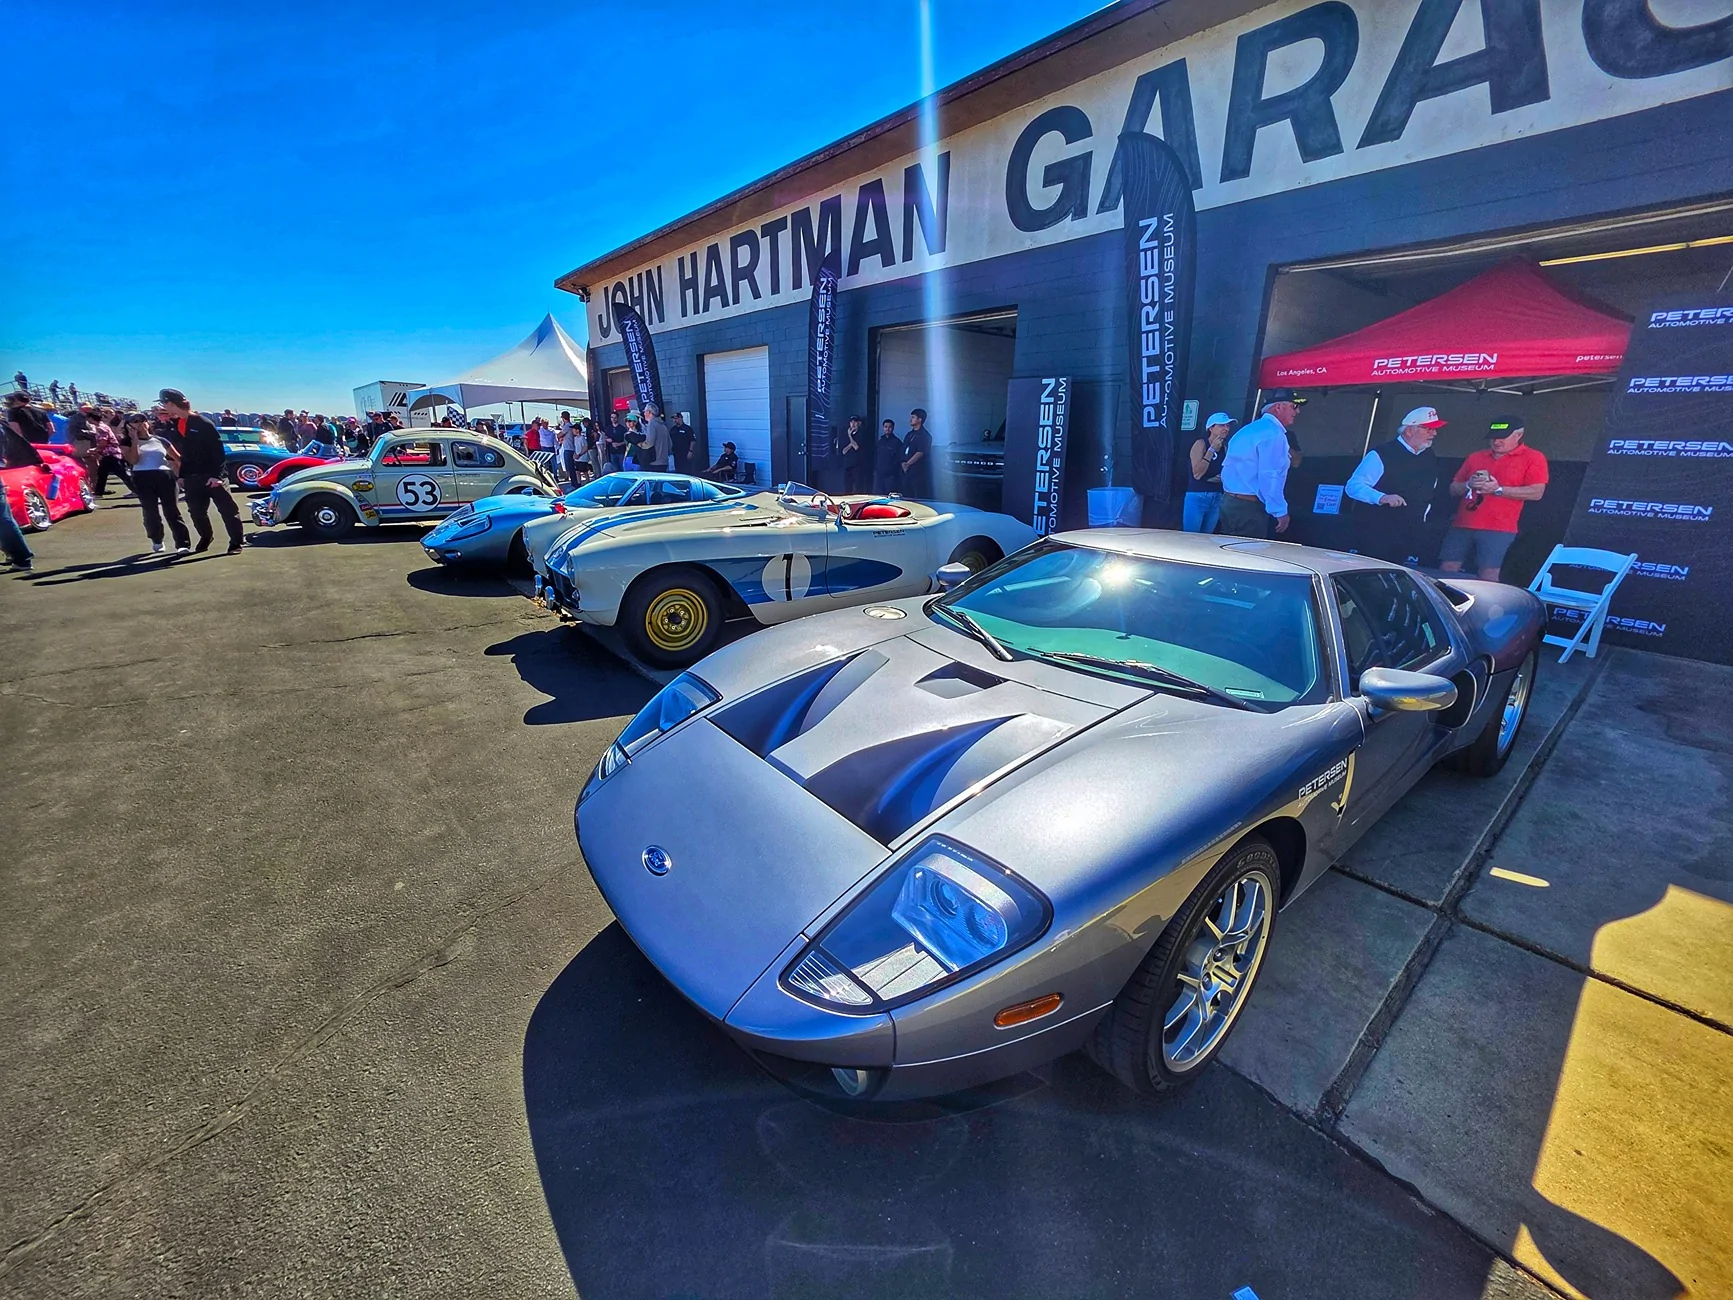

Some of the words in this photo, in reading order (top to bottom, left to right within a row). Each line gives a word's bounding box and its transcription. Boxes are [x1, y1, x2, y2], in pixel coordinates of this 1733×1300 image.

[598, 265, 665, 338] JOHN
[677, 150, 950, 318] HARTMAN
[1162, 213, 1175, 303] MUSEUM
[825, 278, 833, 325] MUSEUM
[632, 319, 645, 353] MUSEUM
[816, 278, 827, 393] PETERSEN
[1138, 216, 1160, 428] PETERSEN
[1648, 318, 1725, 329] AUTOMOTIVE
[623, 319, 650, 404] PETERSEN
[641, 355, 655, 402] AUTOMOTIVE
[821, 329, 830, 393] AUTOMOTIVE
[1159, 310, 1174, 428] AUTOMOTIVE
[1288, 368, 1315, 376] Angeles,
[1371, 366, 1440, 376] AUTOMOTIVE
[1442, 364, 1495, 373] MUSEUM
[1373, 353, 1498, 369] PETERSEN
[1627, 386, 1701, 394] AUTOMOTIVE
[1054, 377, 1067, 451] MUSEUM
[1033, 378, 1056, 536] ETERSEN
[1607, 449, 1677, 457] AUTOMOTIVE
[1609, 440, 1733, 451] PETERSEN
[403, 481, 438, 506] 53
[1048, 457, 1061, 535] TOMOTIVE
[1590, 499, 1713, 516] PETERSEN
[1588, 508, 1654, 518] AUTOMOTIVE
[1658, 513, 1709, 522] MUSEUM
[782, 552, 793, 601] 1
[1637, 570, 1686, 581] MUSEUM
[1553, 607, 1666, 632] PETRSEN
[1616, 625, 1663, 637] MUSEUM
[1298, 757, 1348, 800] PETERSEN
